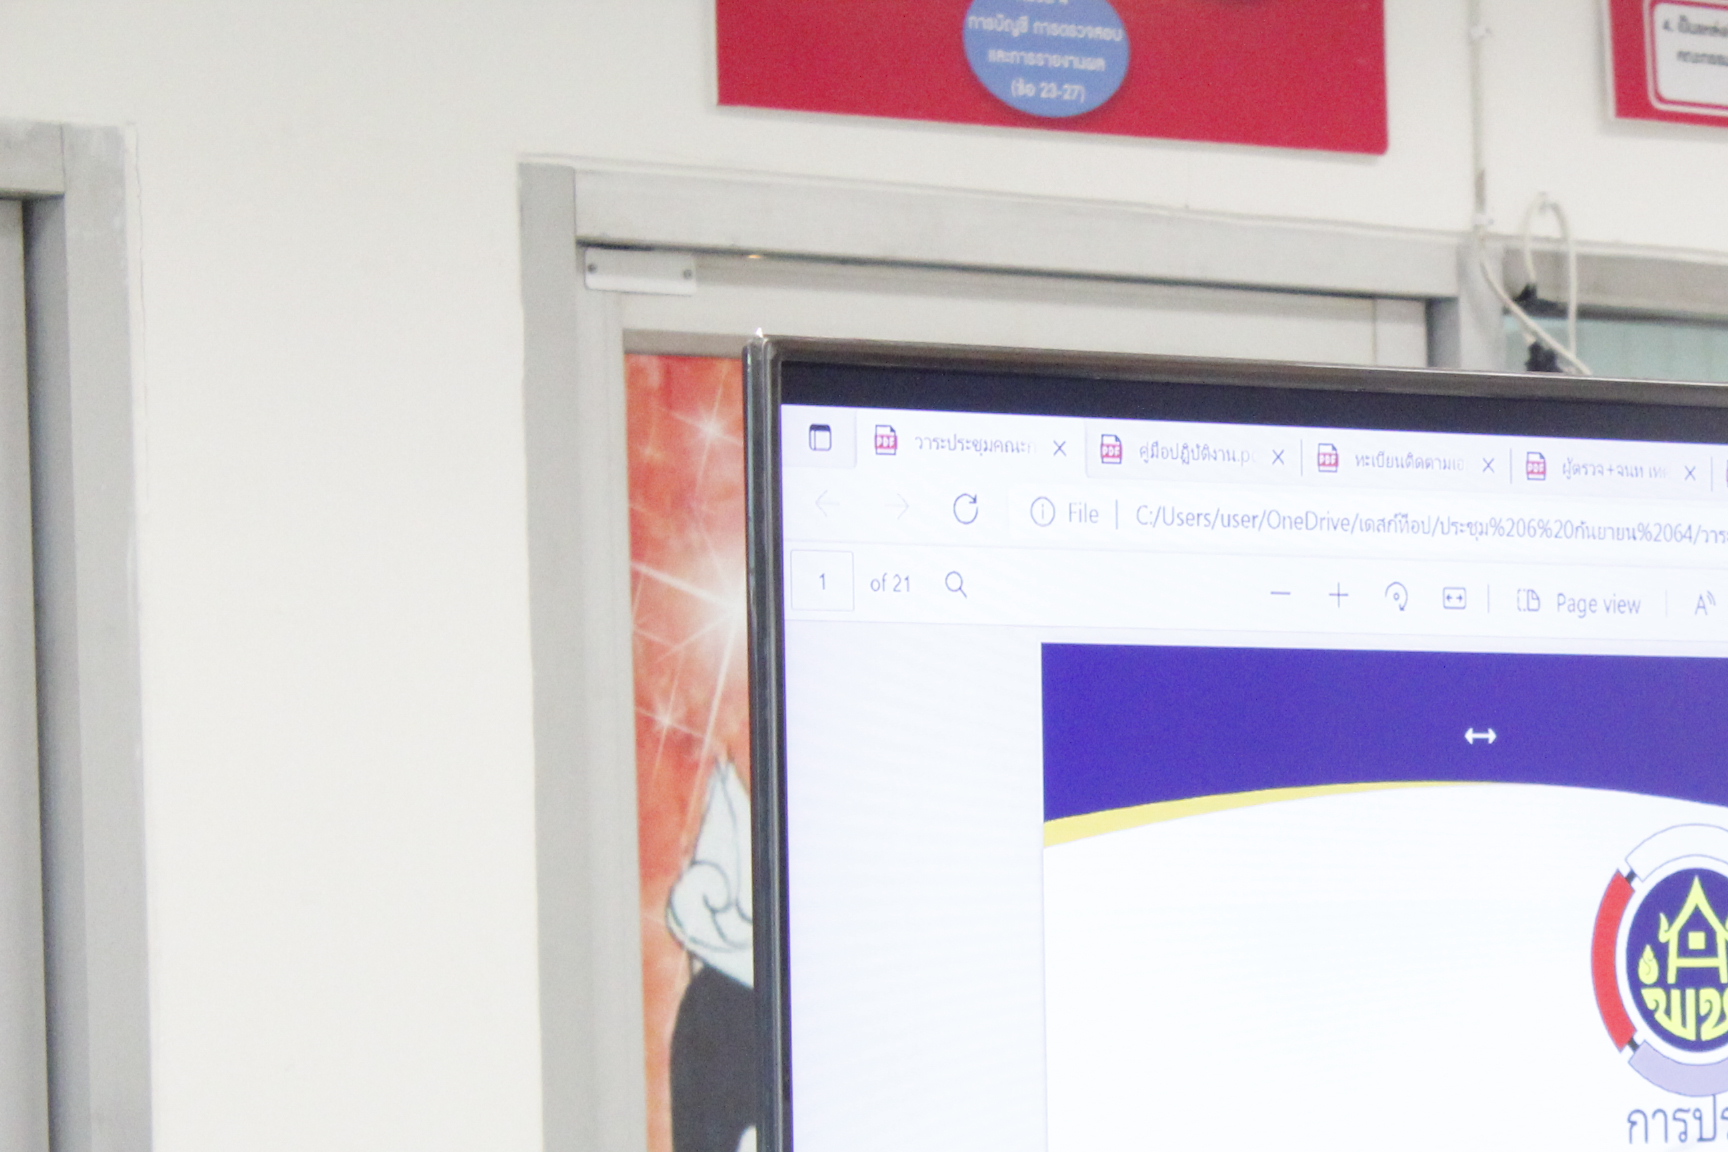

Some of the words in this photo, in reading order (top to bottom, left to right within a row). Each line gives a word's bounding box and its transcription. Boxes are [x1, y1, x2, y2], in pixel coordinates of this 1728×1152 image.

[1068, 502, 1099, 524] File
[818, 573, 827, 590] 1
[870, 573, 887, 592] of
[892, 573, 911, 593] 21
[1557, 593, 1598, 619] Page
[1603, 595, 1641, 615] view
